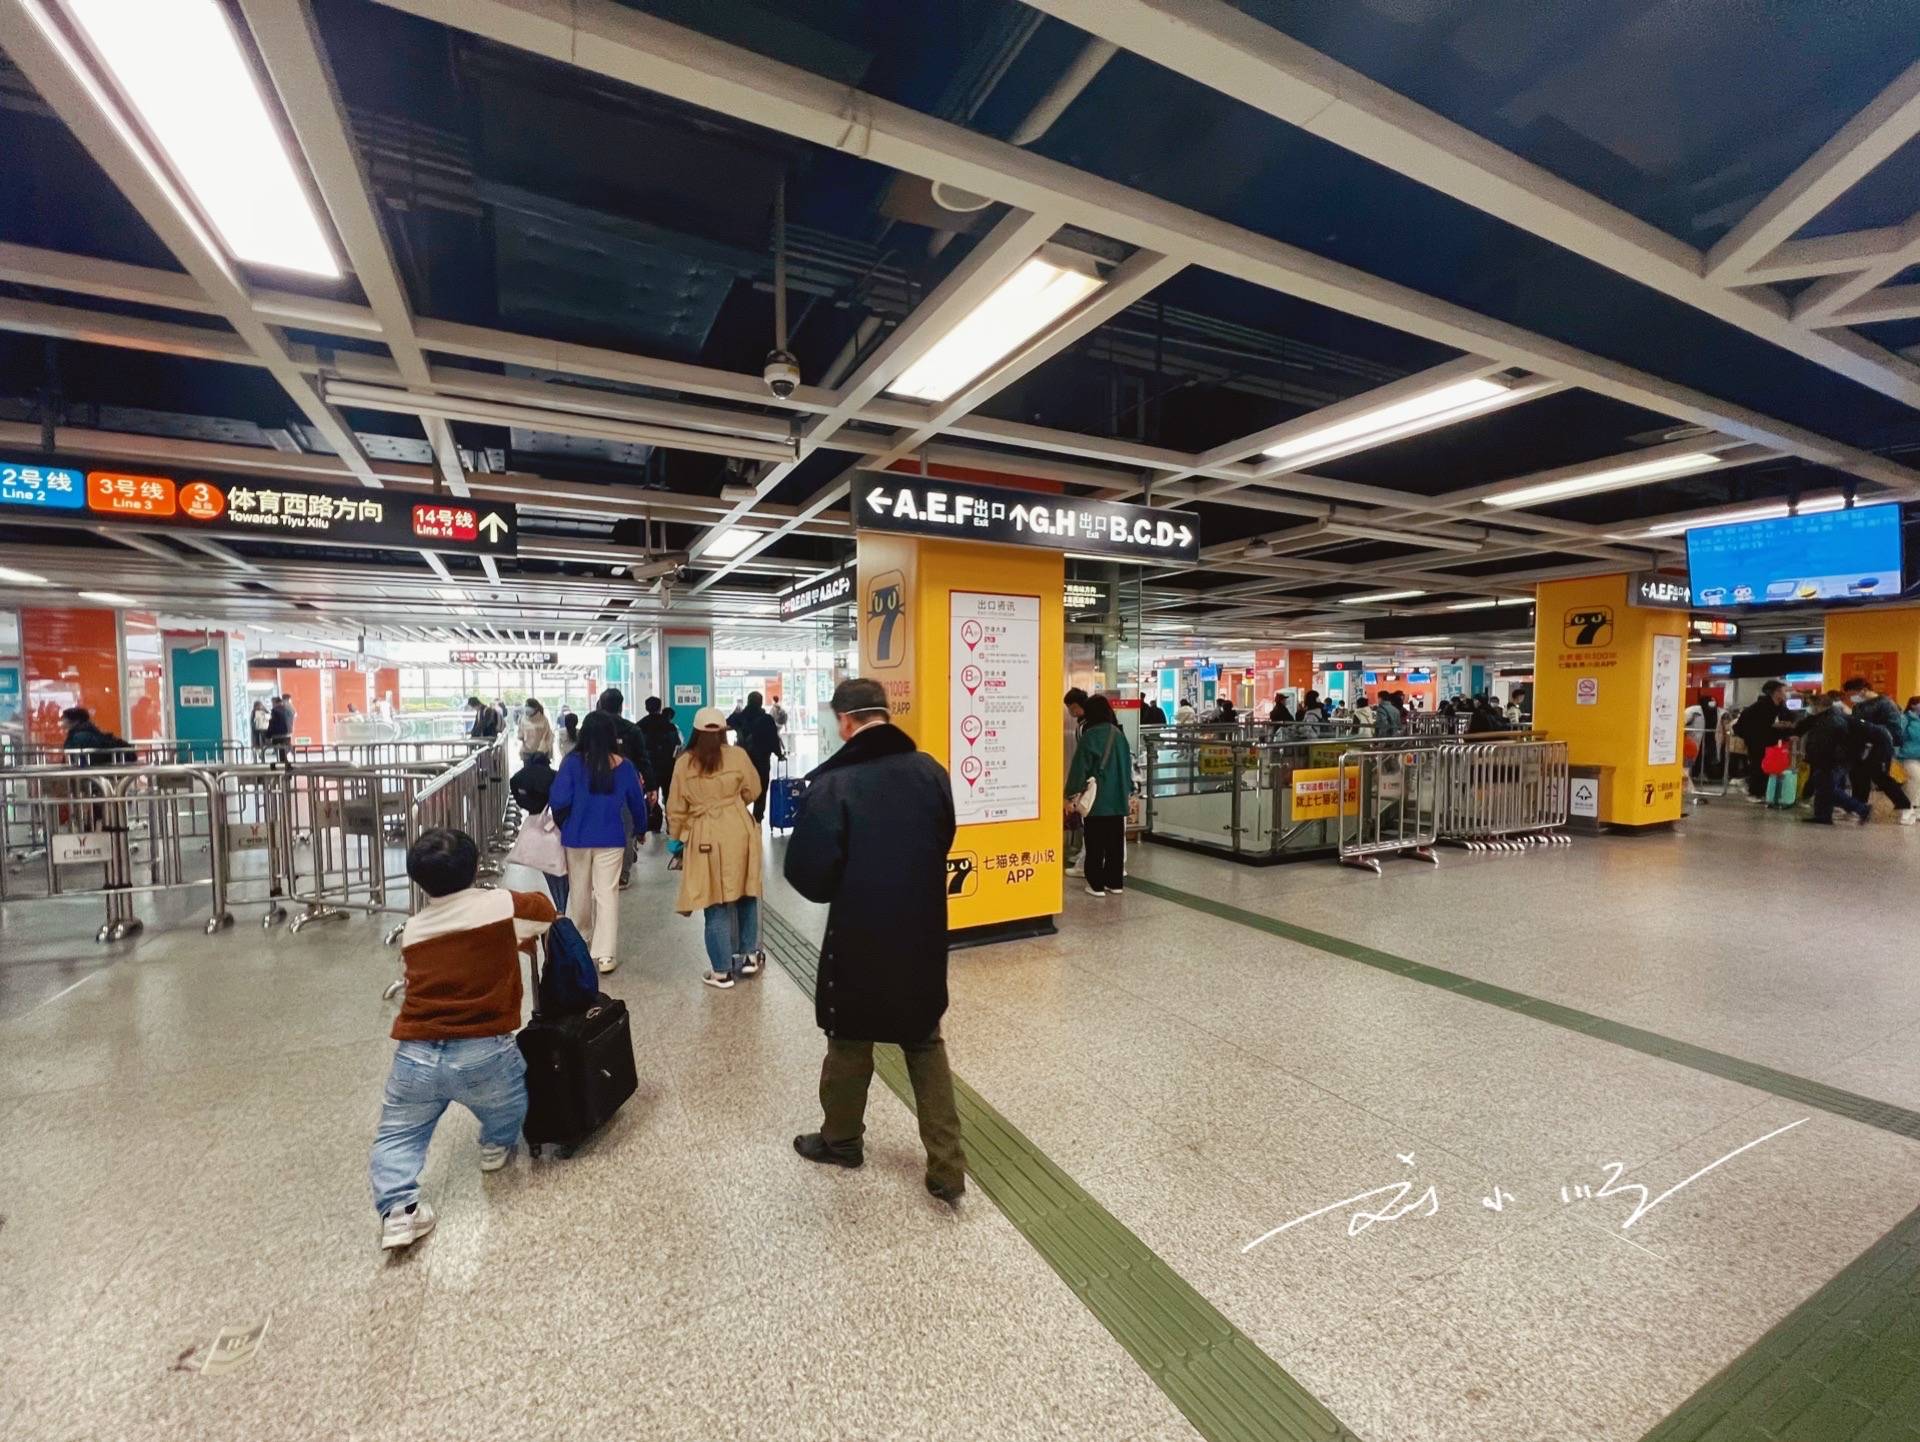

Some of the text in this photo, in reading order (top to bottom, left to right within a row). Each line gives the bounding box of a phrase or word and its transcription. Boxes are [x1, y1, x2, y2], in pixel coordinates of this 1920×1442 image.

[2, 468, 72, 492] 2号线
[99, 479, 164, 500] 3号线
[2, 487, 46, 501] Line 2
[194, 484, 209, 501] 3
[112, 498, 153, 510] Line 3
[227, 486, 383, 522] 体育西路方向
[228, 510, 279, 525] Towards
[280, 514, 305, 528] Tiyu
[307, 517, 329, 529] Xilu
[416, 508, 474, 528] 14号线
[893, 489, 1175, 547] A.E.F 出口 G.H 出口 B.C.D
[416, 524, 453, 536] Line 14
[964, 625, 974, 638] A
[983, 849, 1056, 870] 七猫免费小说
[1006, 868, 1034, 885] APP
